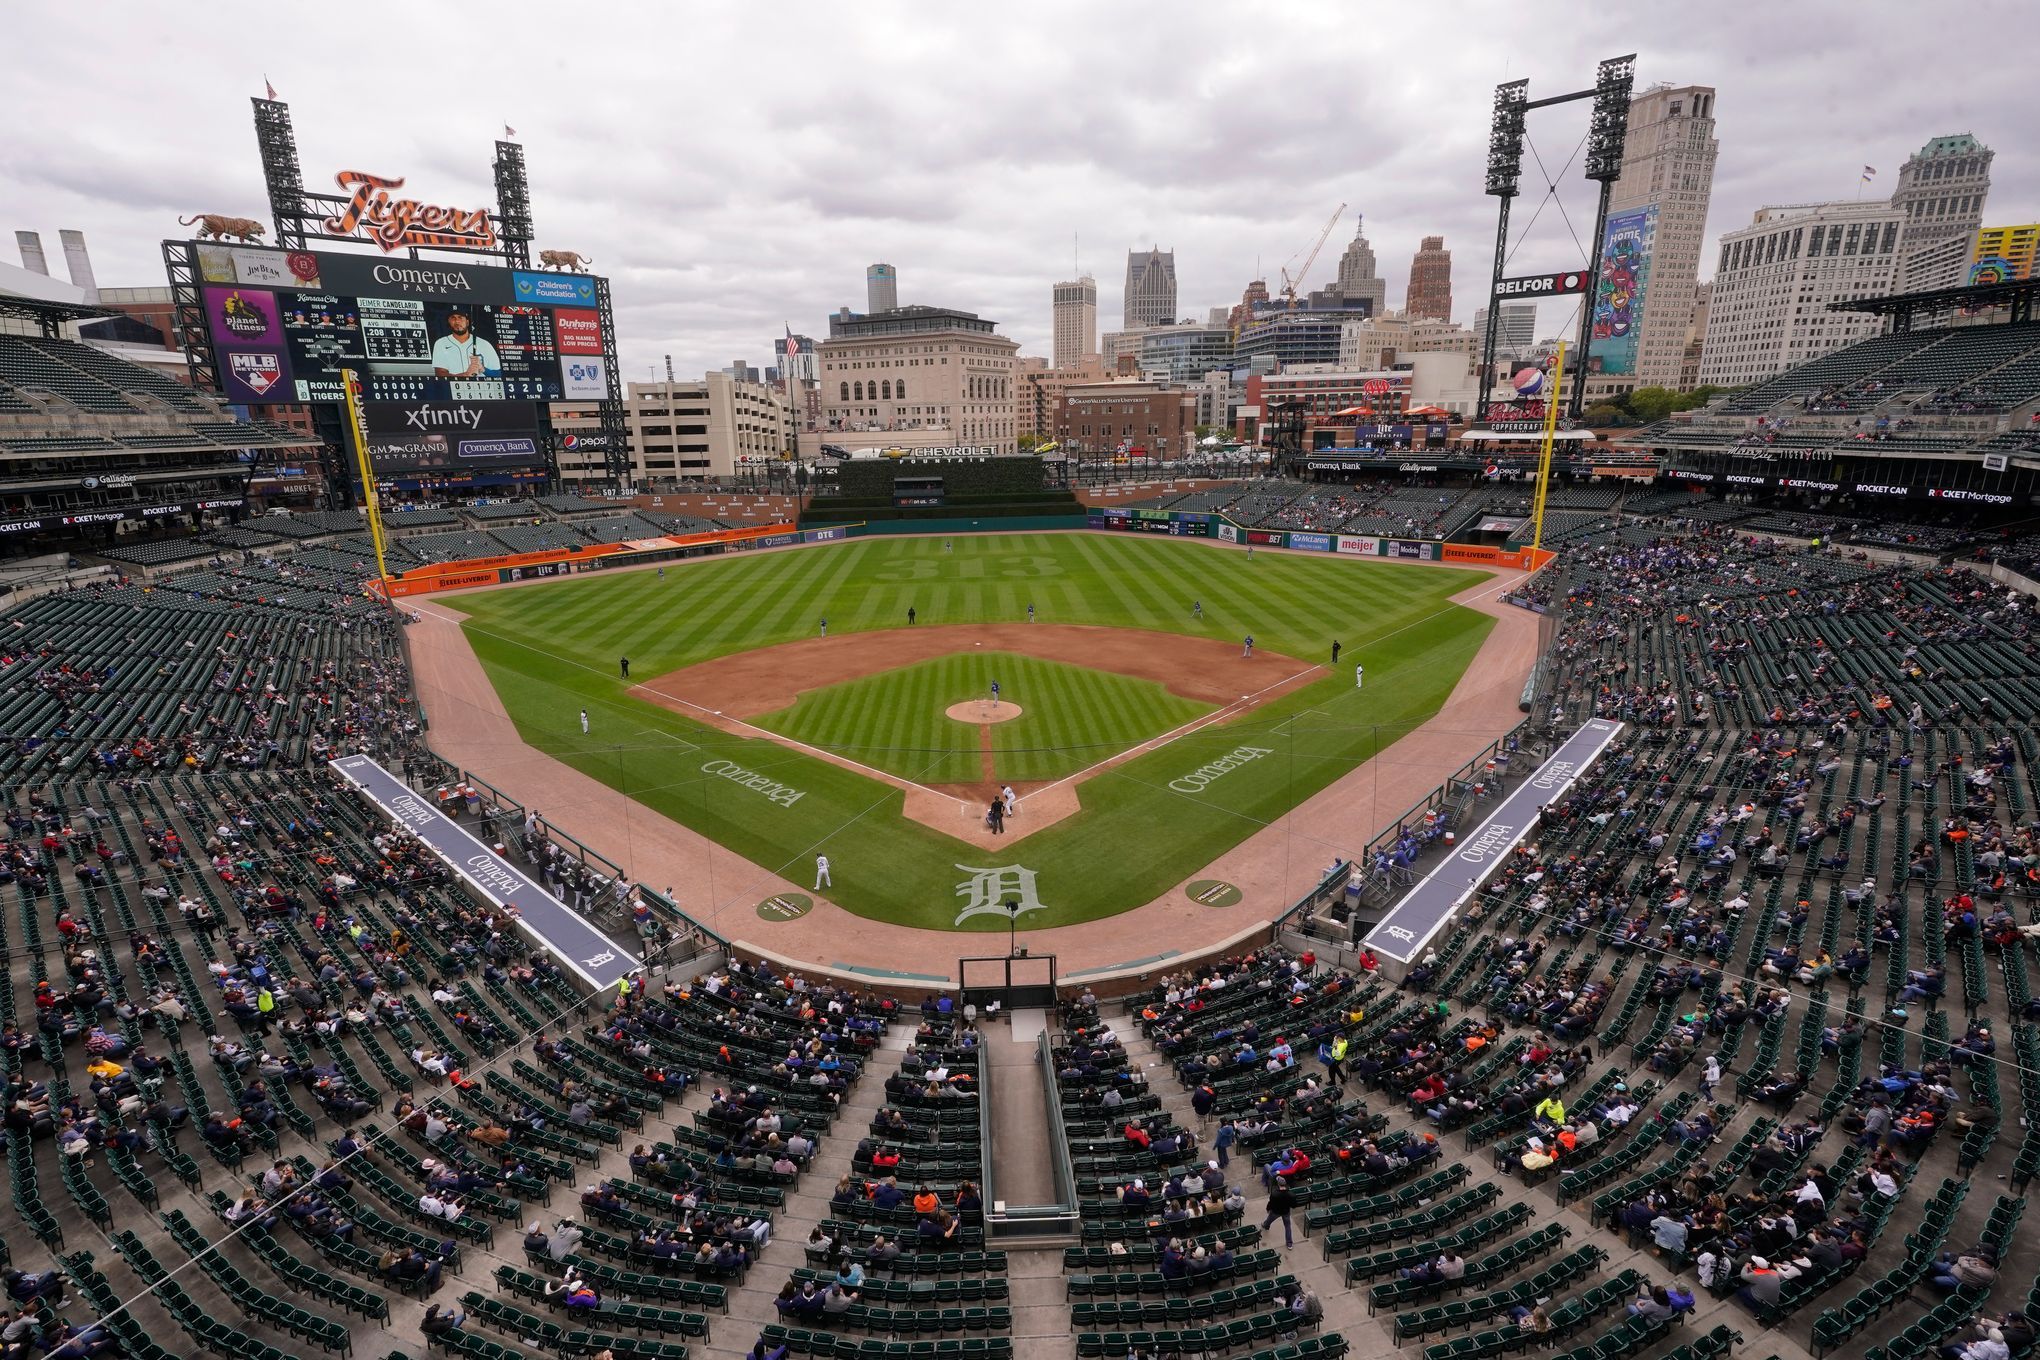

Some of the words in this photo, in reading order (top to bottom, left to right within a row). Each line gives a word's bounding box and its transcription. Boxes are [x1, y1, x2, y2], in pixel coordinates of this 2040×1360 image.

[323, 170, 497, 254] Tigers
[1609, 230, 1641, 248] HOME
[247, 266, 259, 276] JIM
[260, 264, 280, 277] BEAM
[403, 283, 447, 294] PARK
[538, 281, 573, 290] Children's
[1495, 278, 1554, 294] BELFOR
[536, 289, 576, 298] Foundation
[297, 294, 324, 303] Kansas
[324, 295, 339, 304] City
[359, 299, 380, 307] JEIMER
[382, 301, 418, 309] CANDELARIO
[483, 305, 492, 313] 46
[226, 317, 258, 325] planet
[559, 319, 597, 329] Dunham's
[232, 323, 266, 332] fitness
[391, 329, 402, 337] 13
[412, 330, 422, 338] 47
[232, 355, 276, 367] MLB
[310, 381, 346, 390] ROYALS
[373, 382, 379, 390] 0
[382, 382, 388, 390] 0
[391, 382, 397, 390] 0
[400, 382, 406, 390] 0
[409, 382, 415, 390] 0
[418, 382, 424, 390] 0
[508, 383, 515, 393] 3
[522, 384, 529, 392] 2
[536, 384, 543, 393] 0
[1366, 380, 1389, 394] AAA
[312, 392, 346, 400] TIGERS
[375, 392, 381, 400] 0
[384, 392, 390, 400] 1
[393, 392, 399, 400] 0
[402, 392, 408, 400] 0
[411, 392, 417, 400] 4
[405, 404, 483, 430] xfinity
[1377, 424, 1393, 433] Lite
[1491, 423, 1543, 431] COPPERCRAFT
[507, 441, 529, 451] Bank
[579, 436, 607, 447] pepsi
[402, 443, 445, 453] GRAND
[914, 446, 997, 457] CHEVROLET
[375, 452, 431, 460] DETROIT
[1400, 462, 1421, 473] Bally
[1499, 468, 1521, 477] pepsi
[100, 475, 137, 484] Gallagher
[1669, 470, 1690, 478] ROCKET
[1690, 472, 1714, 481] Mortgage
[1726, 475, 1750, 483] ROCKET
[1751, 476, 1765, 484] CAN
[283, 485, 312, 493] MARKET
[1779, 479, 1806, 487] ROCKET
[1806, 480, 1839, 490] Mortgage
[1856, 484, 1889, 493] ROCKET
[1890, 486, 1908, 495] CAN
[603, 488, 616, 496] 507
[620, 488, 639, 496] 3084
[1928, 489, 1967, 498] ROCKET
[1967, 491, 2012, 504] Mortgage
[197, 500, 219, 509] ROCKET
[219, 499, 243, 507] Mortgage
[466, 498, 511, 507] CHEVROLET
[142, 507, 168, 516] ROCKET
[168, 505, 182, 513] CAN
[392, 503, 441, 513] CHEVROLET
[62, 514, 93, 525] ROCKET
[93, 512, 124, 521] Mortgage
[0, 522, 22, 532] CKET
[23, 521, 41, 530] CAN
[817, 530, 834, 539] DTE
[1219, 534, 1235, 542] VISION
[1300, 535, 1329, 544] McLaren
[1342, 540, 1374, 552] meijer
[1400, 546, 1419, 555] Modelo
[484, 557, 508, 565] DELIVERY
[538, 564, 553, 576] Lite
[1555, 768, 1573, 784] PARK
[395, 806, 415, 820] PARK
[1488, 835, 1511, 856] PARK
[470, 869, 497, 889] PARK
